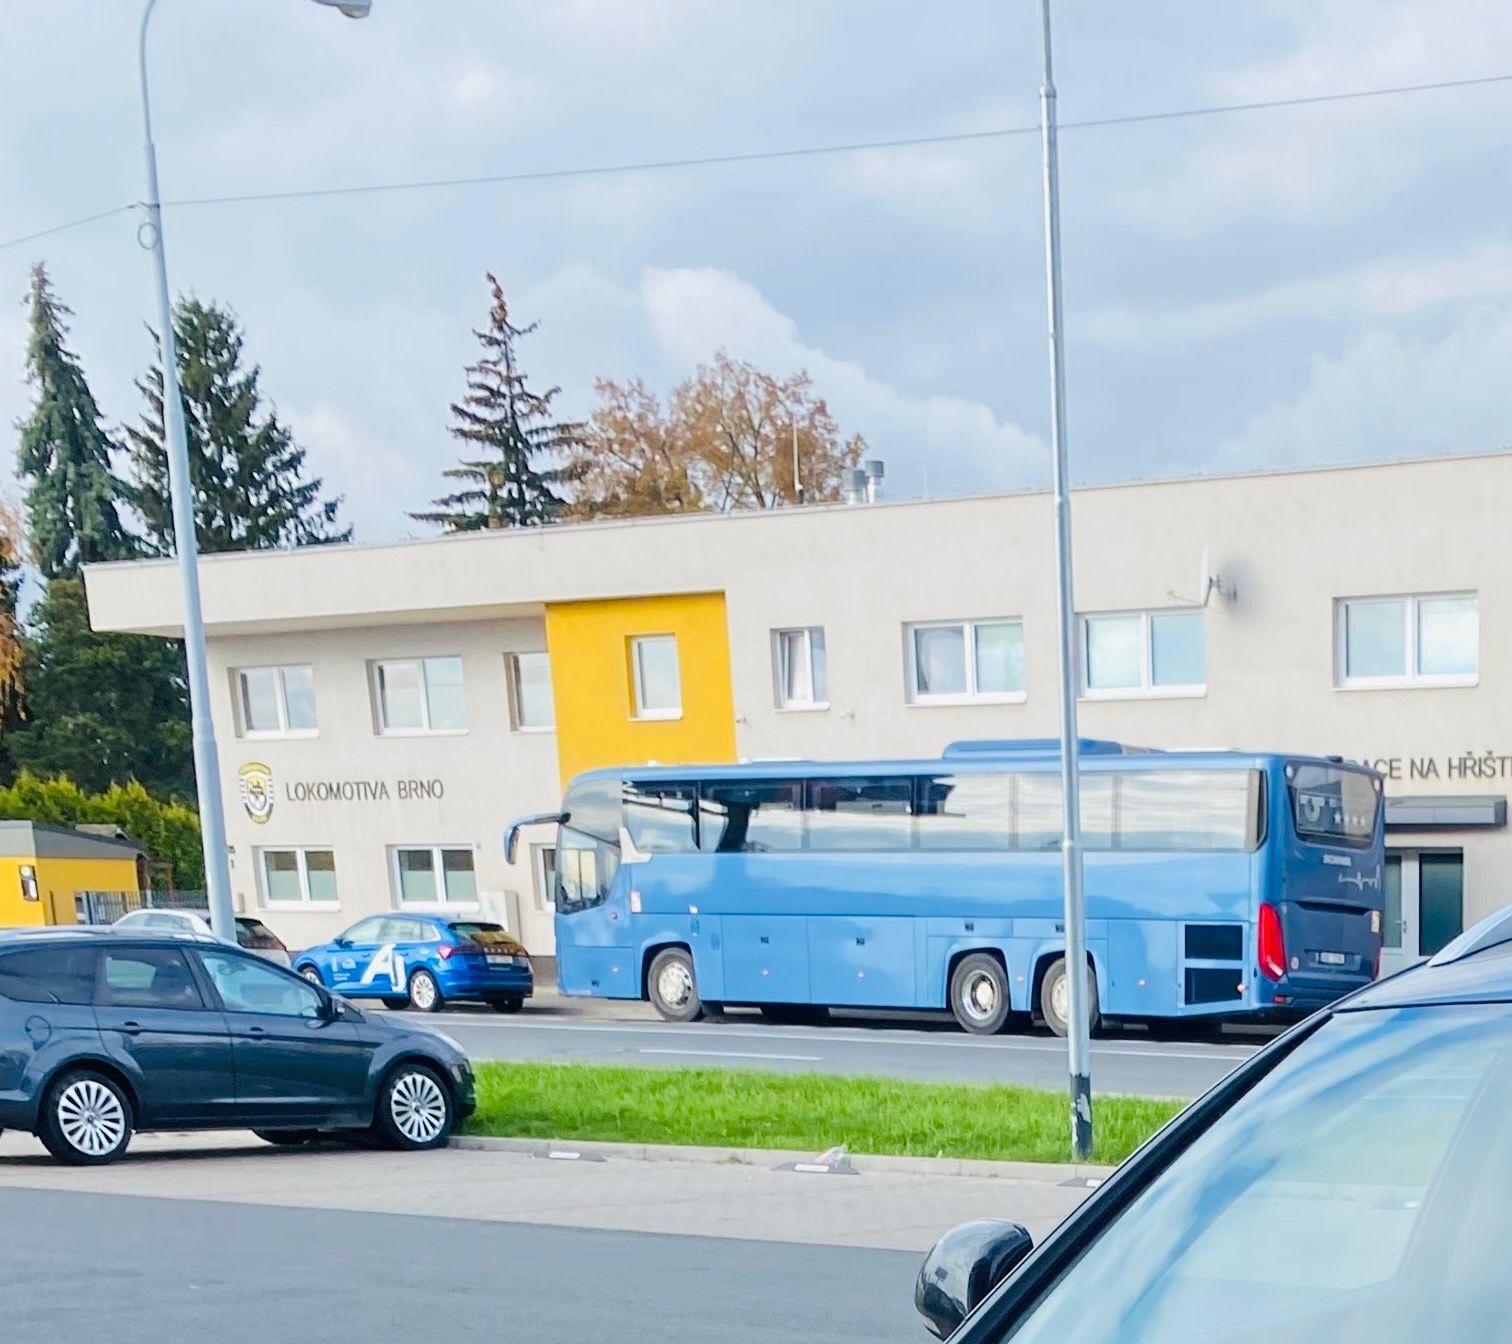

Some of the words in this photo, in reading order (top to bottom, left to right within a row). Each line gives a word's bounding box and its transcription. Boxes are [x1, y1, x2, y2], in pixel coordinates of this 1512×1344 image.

[1410, 757, 1439, 779] NA
[286, 781, 390, 801] LOKOMOTIVA
[397, 779, 444, 800] BRNO
